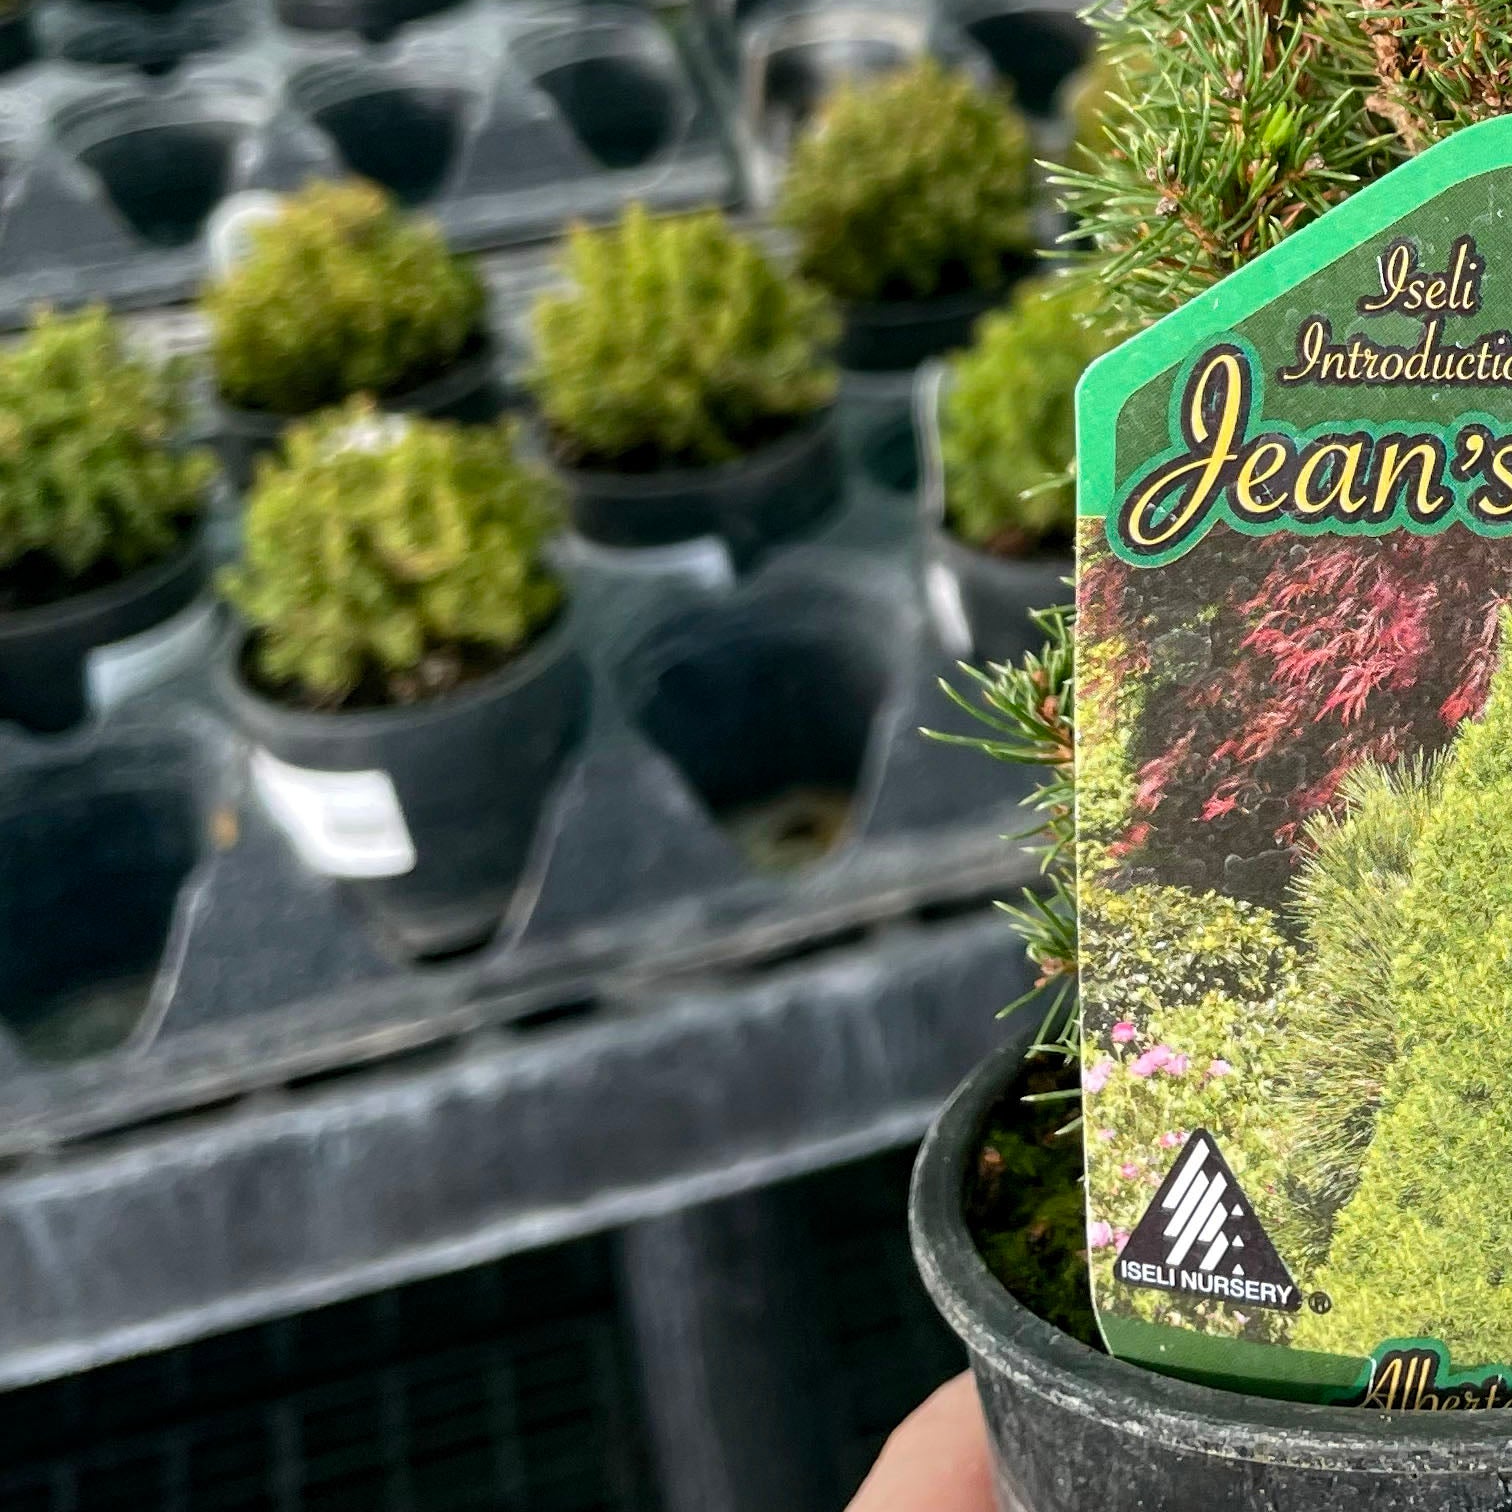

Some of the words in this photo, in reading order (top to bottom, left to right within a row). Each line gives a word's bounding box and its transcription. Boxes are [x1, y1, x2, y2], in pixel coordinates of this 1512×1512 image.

[1364, 243, 1477, 311] Iseli
[1120, 1259, 1176, 1288] ISELI
[1180, 1269, 1293, 1305] NURSERY
